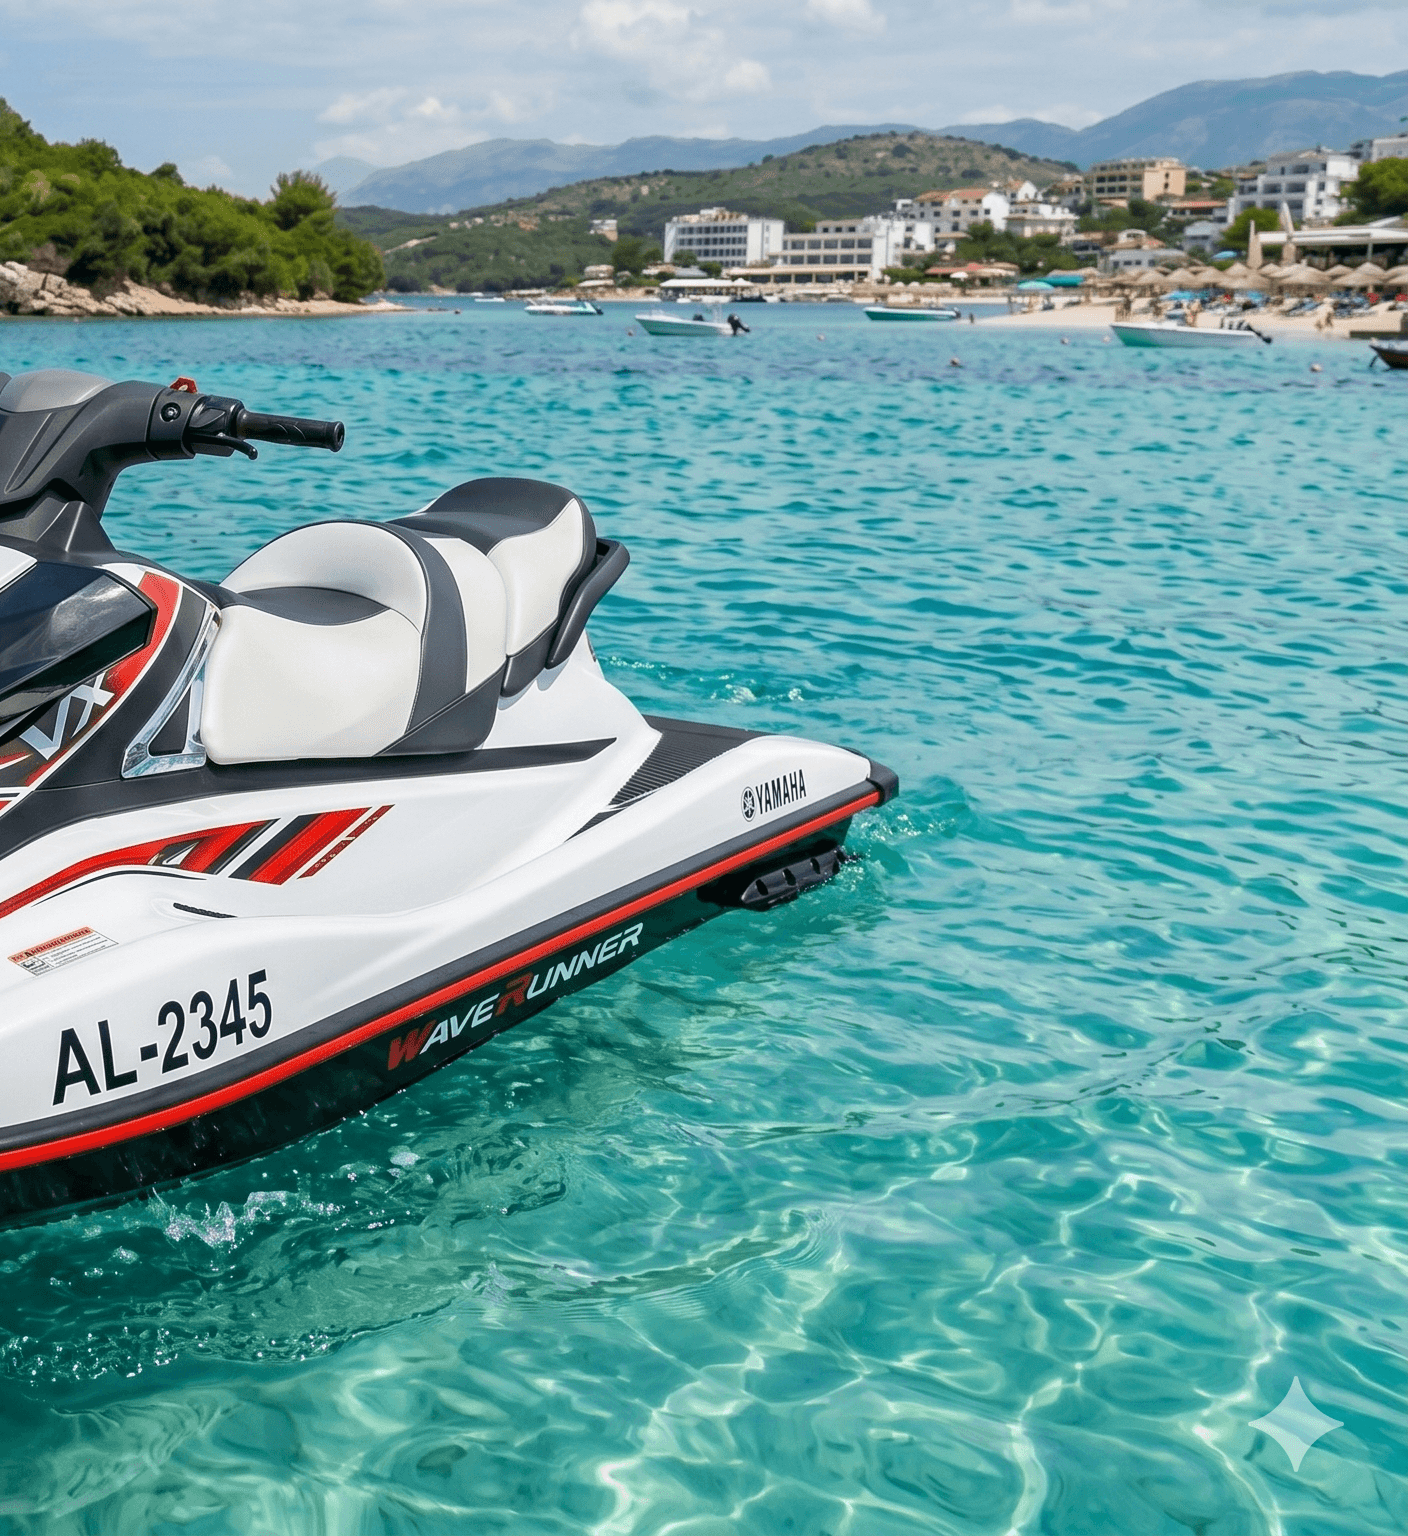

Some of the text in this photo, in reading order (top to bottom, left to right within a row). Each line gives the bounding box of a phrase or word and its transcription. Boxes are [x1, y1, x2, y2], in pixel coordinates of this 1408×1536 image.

[19, 671, 115, 761] VX
[755, 769, 807, 815] YAMAHA
[52, 969, 273, 1106] AL-2345
